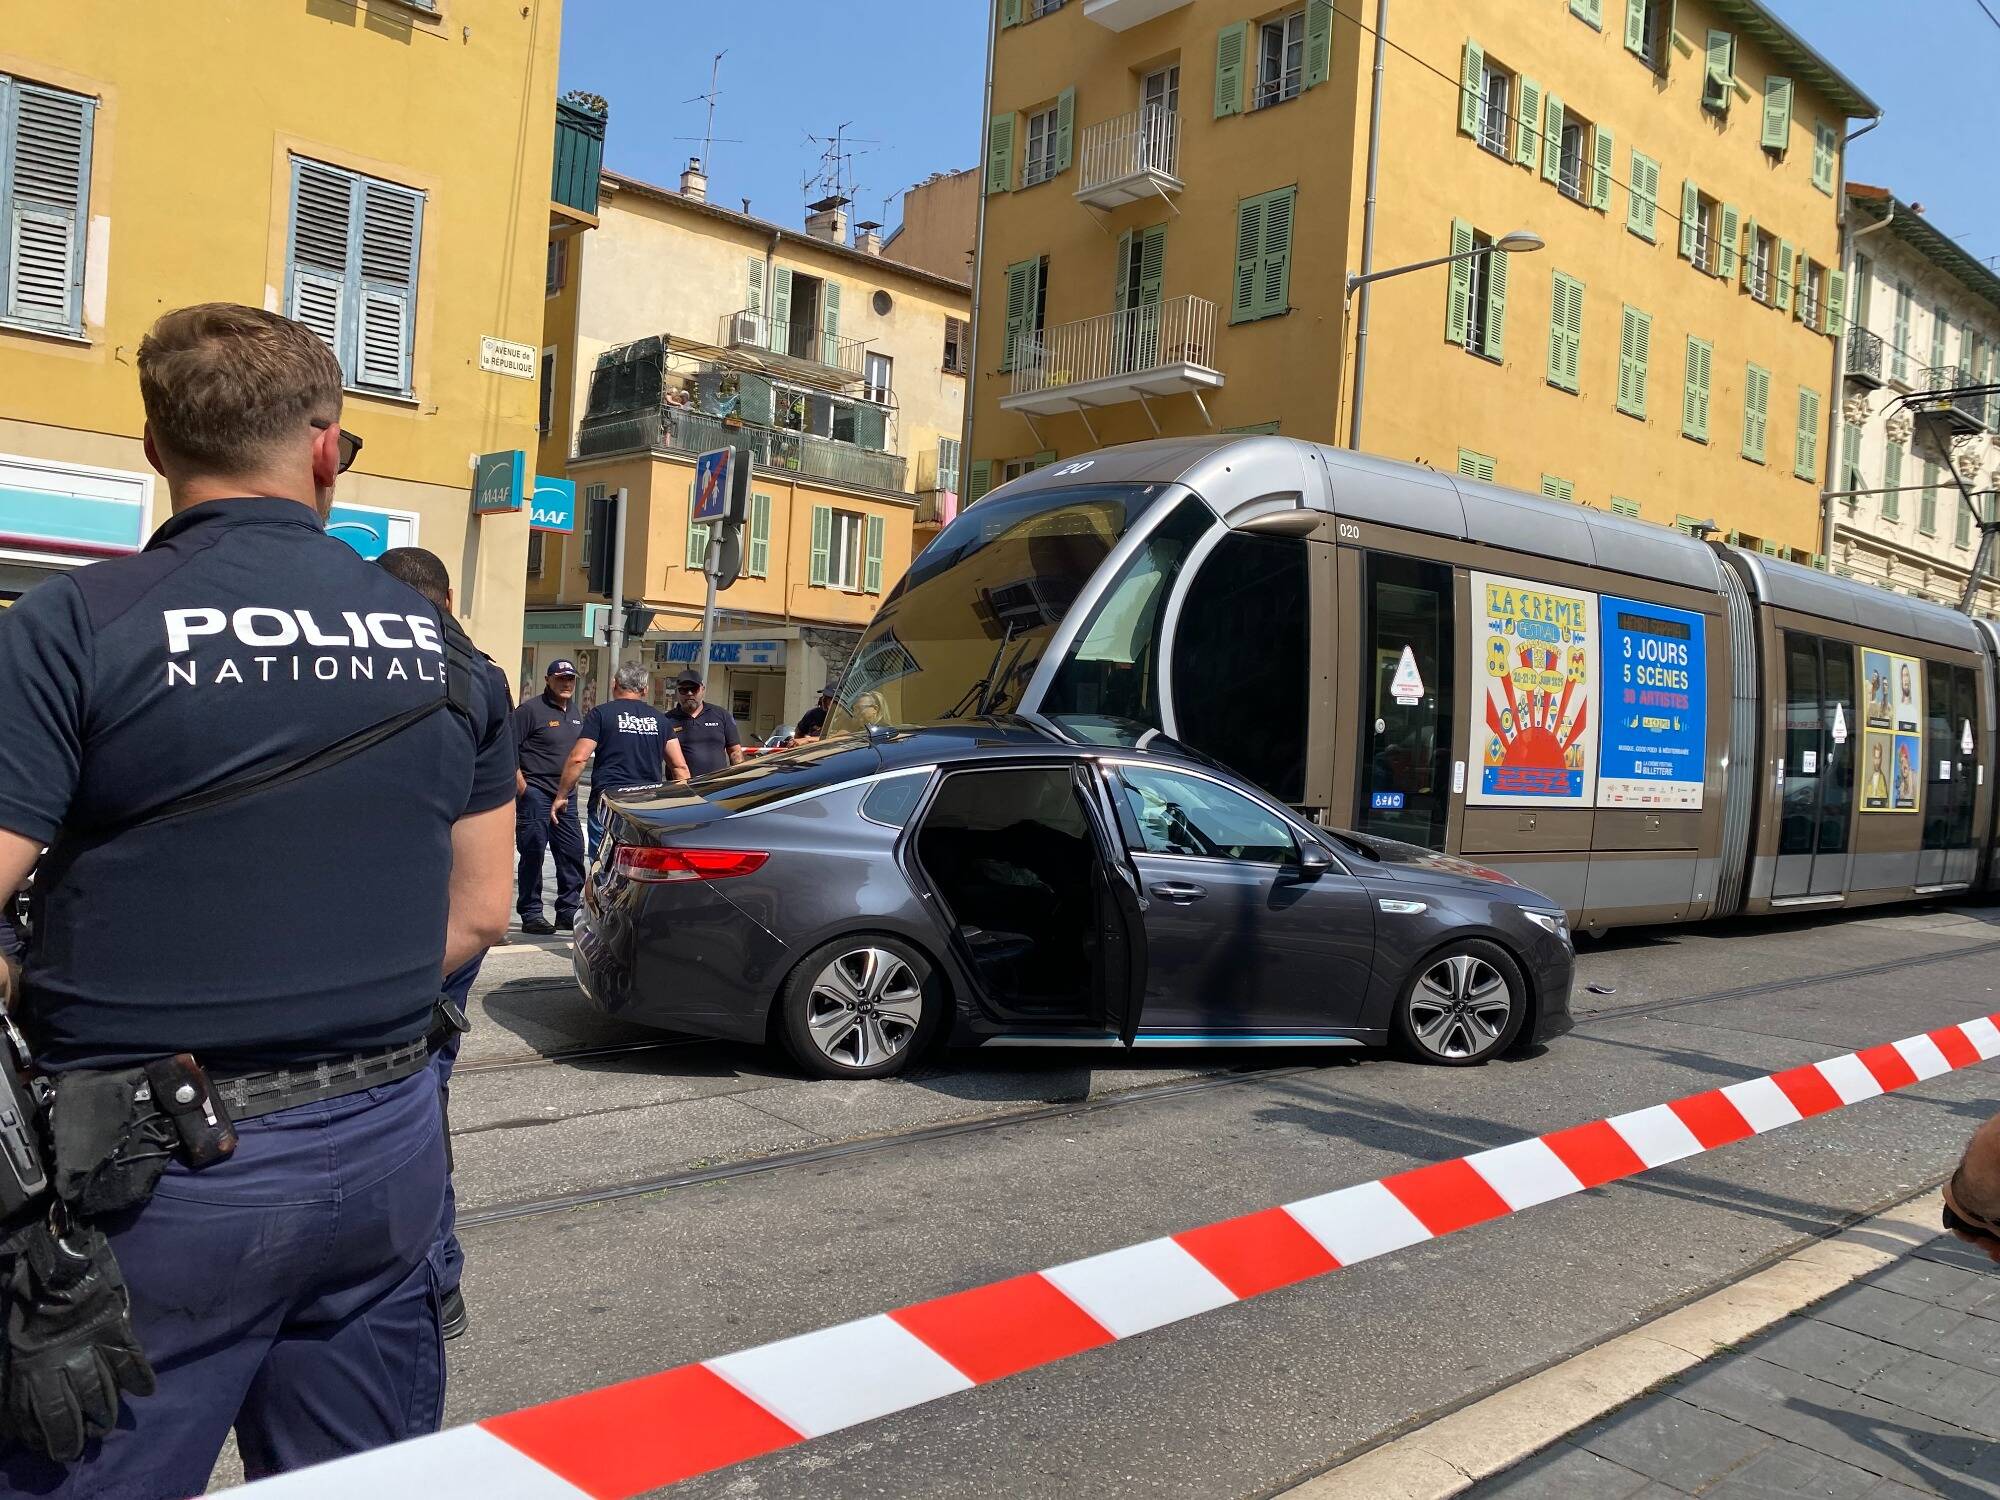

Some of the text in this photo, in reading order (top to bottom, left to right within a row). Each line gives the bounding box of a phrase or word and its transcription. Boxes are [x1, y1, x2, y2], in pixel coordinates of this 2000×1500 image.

[495, 345, 531, 360] AVENUE de
[483, 355, 533, 373] la RÉPUBLIQUE
[1052, 460, 1096, 476] 20
[480, 486, 511, 504] MAAF
[1340, 523, 1360, 539] 020
[1491, 590, 1515, 615] LA
[163, 607, 442, 655] POLICE
[1623, 636, 1688, 666] 3 JOURS
[168, 655, 447, 686] NATIONALE
[1623, 663, 1689, 690] 5 SCÈNES
[1639, 690, 1689, 710] ARTISTES
[618, 711, 657, 724] LIGNES
[1643, 767, 1673, 776] BILLETTERIE
